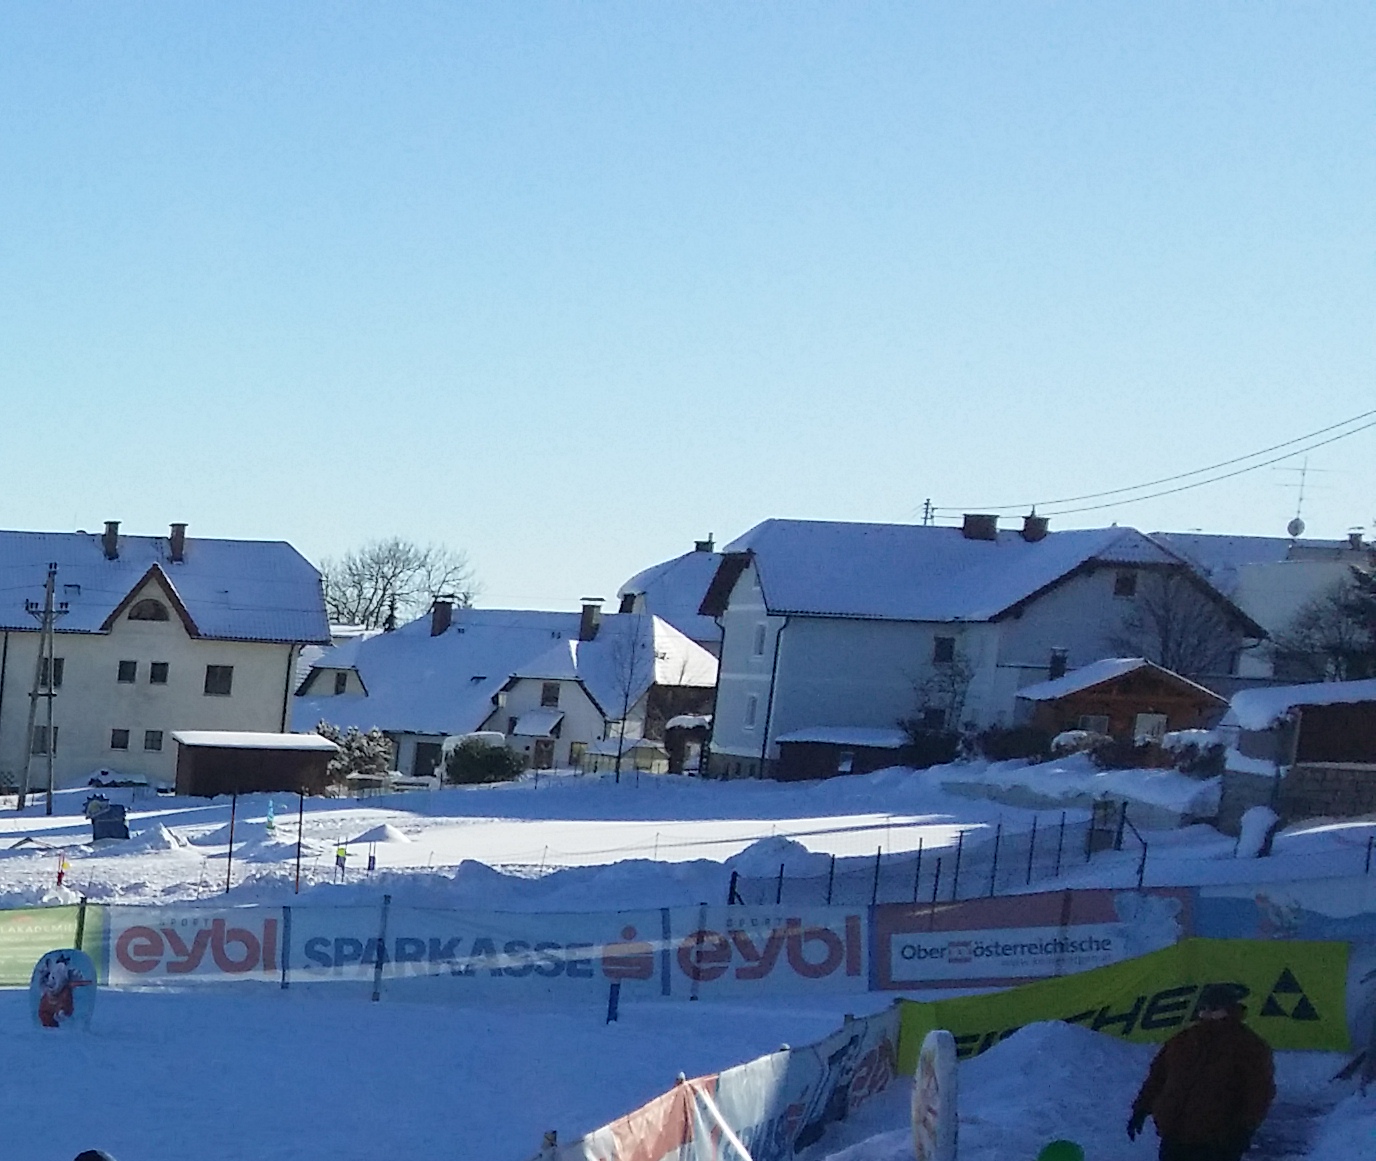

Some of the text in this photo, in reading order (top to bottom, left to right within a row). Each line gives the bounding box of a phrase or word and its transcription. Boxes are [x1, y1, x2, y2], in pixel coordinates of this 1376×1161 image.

[115, 918, 278, 974] eybl
[303, 936, 595, 979] SPARKASSE
[677, 915, 862, 981] eybl
[972, 935, 1112, 959] österreichische
